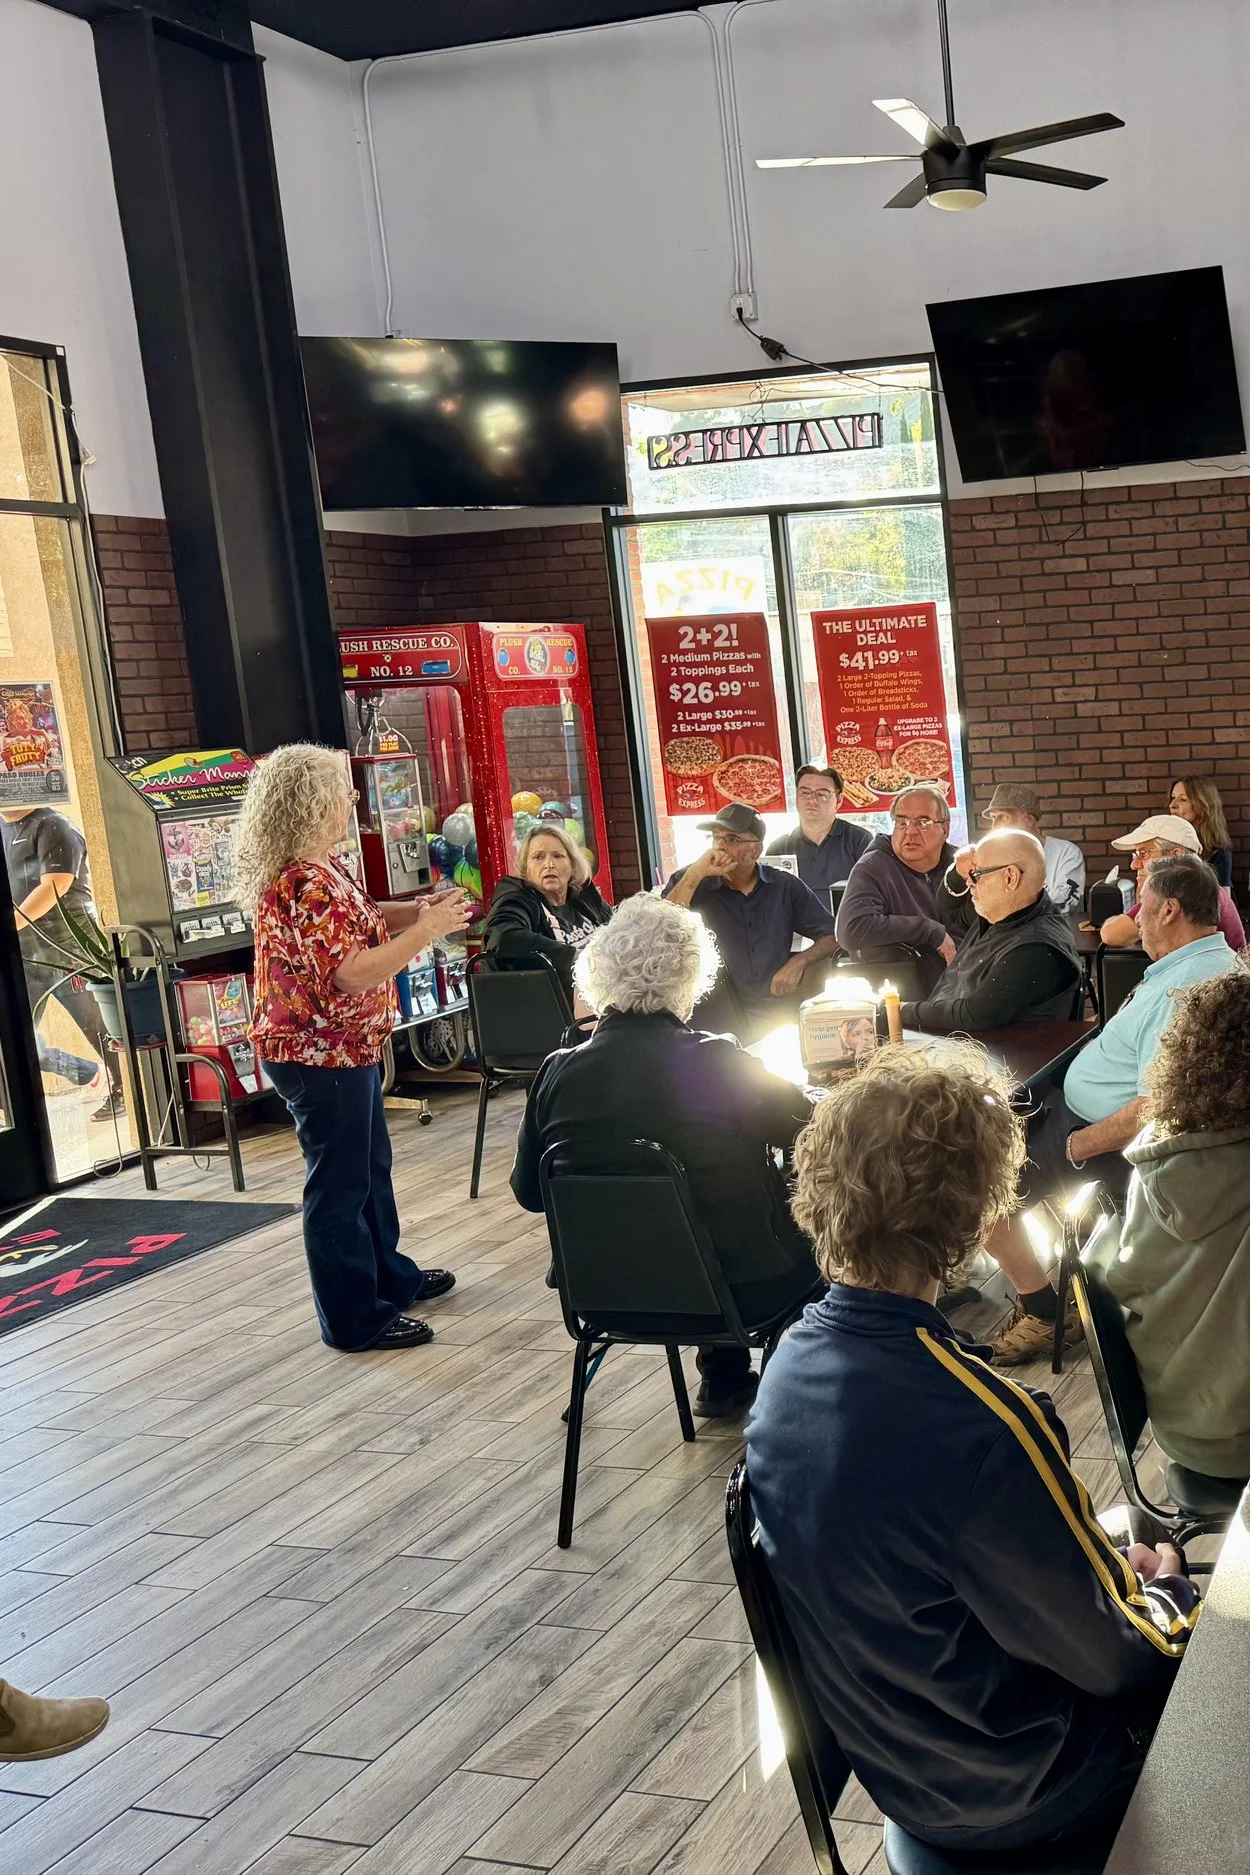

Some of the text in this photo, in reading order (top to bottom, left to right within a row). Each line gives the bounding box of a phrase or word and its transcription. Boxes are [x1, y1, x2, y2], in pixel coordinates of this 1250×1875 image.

[823, 615, 927, 634] THE ULTIMATE
[678, 623, 739, 649] 2+2!
[857, 632, 896, 646] DEAL
[339, 636, 454, 653] USH RESCUE CO.
[499, 638, 573, 647] PLUSH RESCUE
[661, 654, 668, 663] 2
[670, 652, 710, 663] Medium
[713, 651, 745, 660] Pizzas
[839, 650, 900, 670] $41.99
[370, 665, 413, 677] NO. 12
[508, 665, 573, 675] CO. NO. 12
[671, 663, 754, 677] 2 Toppings Each
[669, 681, 741, 705] $26.99
[857, 697, 883, 705] Regular
[678, 712, 684, 720] 2
[686, 711, 712, 721] Large
[714, 710, 742, 719] $30.99
[672, 724, 678, 732] 2
[680, 722, 722, 732] Ex-Large
[724, 721, 751, 731] $35.99
[836, 721, 860, 732] PIZZA
[379, 734, 398, 742] $1.00
[837, 735, 861, 745] EXPRESS
[128, 770, 197, 790] Sticker
[677, 782, 704, 794] PIZZA
[181, 793, 209, 801] Collect
[210, 791, 224, 799] The
[678, 798, 705, 808] EXPRESS
